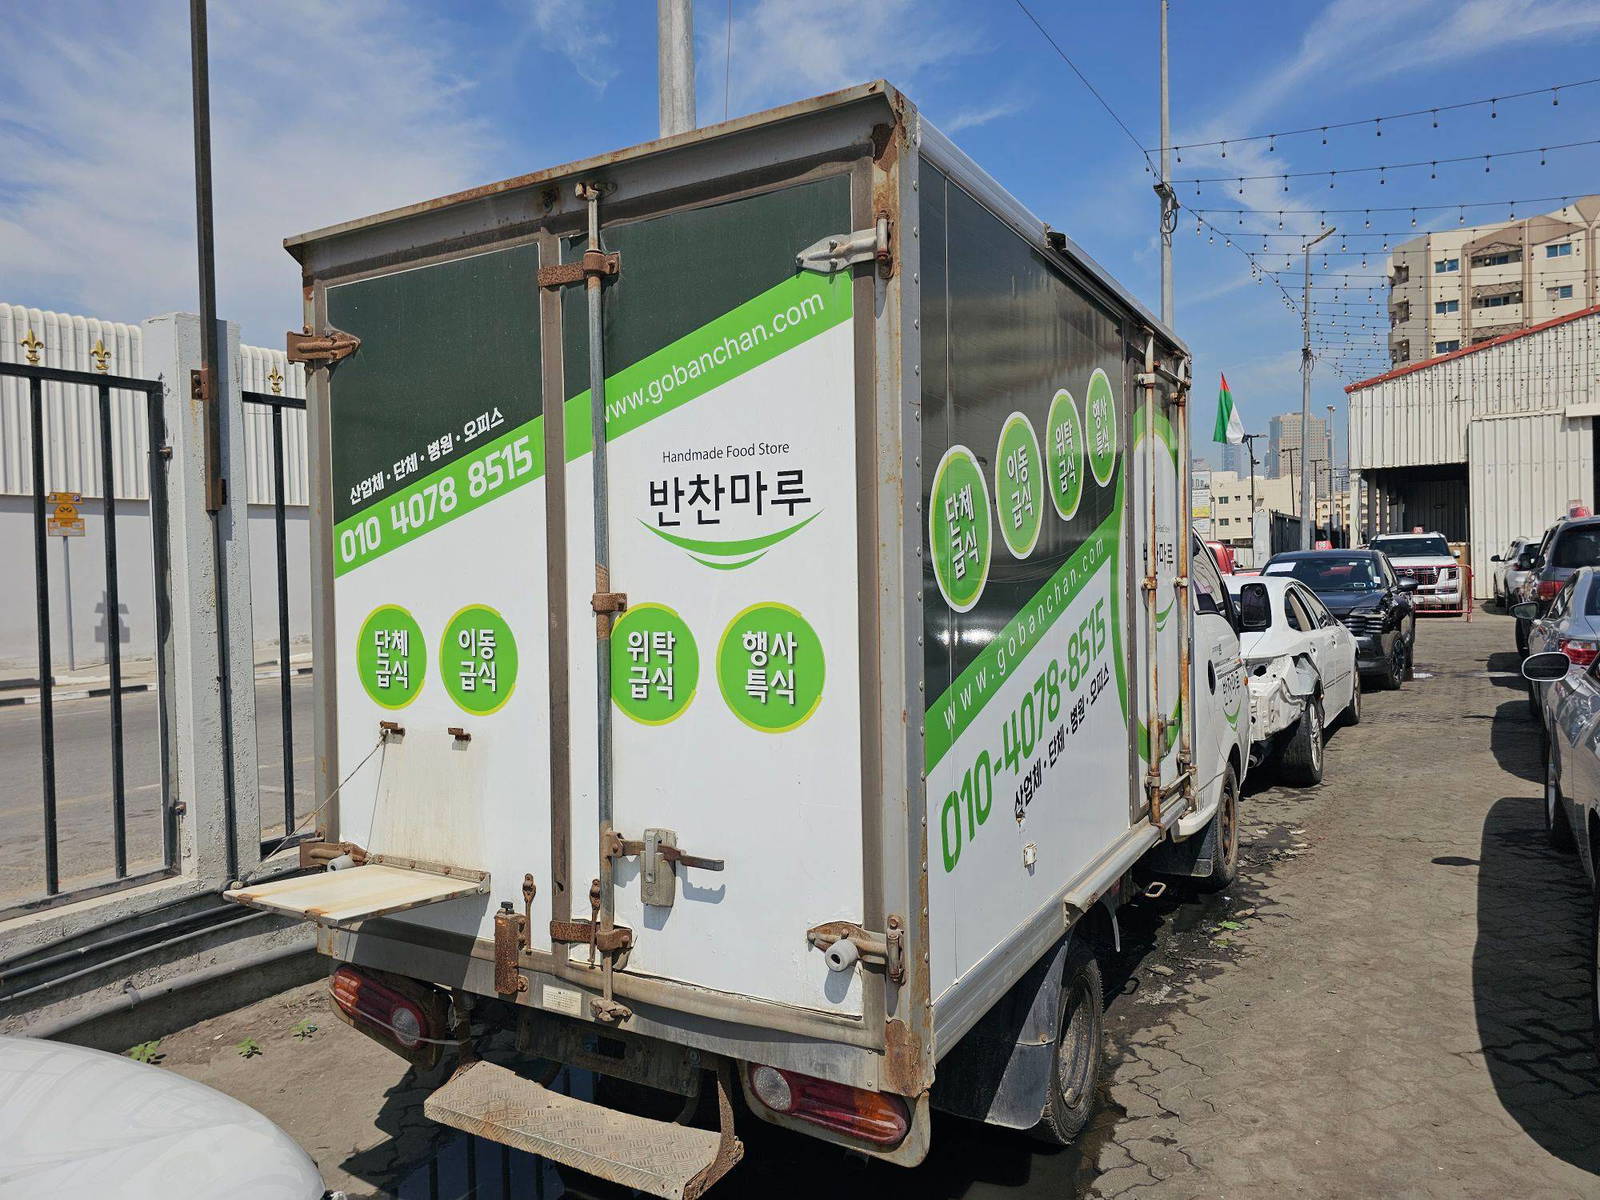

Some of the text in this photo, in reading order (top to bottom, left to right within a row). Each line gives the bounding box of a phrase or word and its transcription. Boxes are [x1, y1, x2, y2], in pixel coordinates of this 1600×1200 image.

[662, 441, 790, 464] Handmade Food Store
[1007, 443, 1028, 484] 이동
[340, 435, 533, 563] 010 4078 8515
[649, 469, 811, 527] 반찬마루
[944, 483, 975, 536] 단체
[1011, 481, 1033, 529] 급식
[951, 525, 979, 580] 급식
[374, 629, 409, 658] 단체
[458, 628, 497, 660] 이동
[627, 630, 675, 664] 위탁
[742, 631, 798, 667] 행사
[943, 538, 1104, 730] www.gobanchan.com
[375, 660, 409, 689] 급식
[459, 661, 497, 692] 급식
[628, 665, 675, 700] 급식
[744, 668, 797, 705] 특식
[941, 597, 1106, 873] 010-4078-8515
